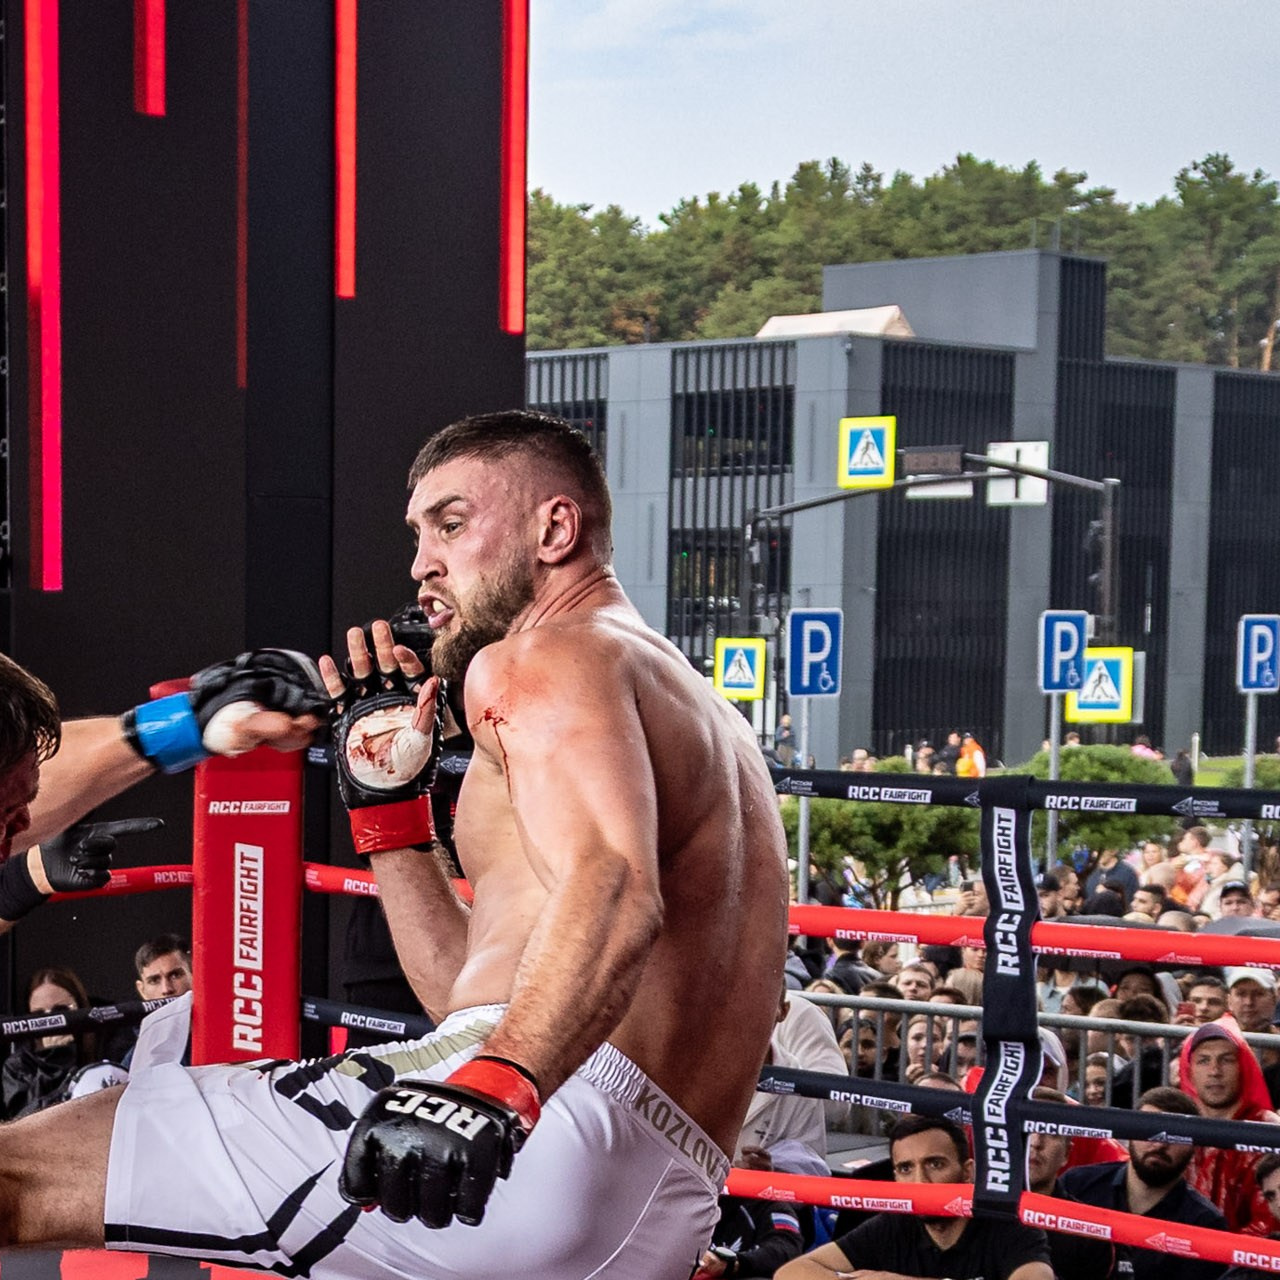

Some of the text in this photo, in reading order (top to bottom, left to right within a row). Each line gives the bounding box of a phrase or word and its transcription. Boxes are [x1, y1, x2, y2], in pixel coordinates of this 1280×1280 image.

[849, 785, 931, 802] RCC FAIRFIGHT
[1045, 795, 1136, 812] RCC FAIRFIGHT
[208, 801, 289, 813] RCC FAIRFIGHT
[154, 872, 178, 883] RCC
[344, 879, 369, 894] RCC
[995, 811, 1022, 976] RCC FAIRFIGHT
[233, 846, 263, 1052] RCC FAIRFIGHT
[3, 1015, 66, 1035] RCC FAIRFIGHT
[341, 1012, 406, 1034] RCC FAIRFIGHT
[830, 1091, 911, 1112] RCC FAIRFIGHT
[385, 1090, 490, 1141] RCC
[985, 1042, 1023, 1192] RCC FAIRFIGHT
[635, 1085, 720, 1179] KOZLOV
[1023, 1120, 1112, 1138] RCC FAIRFIGHT
[831, 1196, 912, 1211] RCC FAIRFIGHT
[1023, 1210, 1111, 1238] RCC FAIRFIGHT
[1233, 1250, 1270, 1268] RCC
